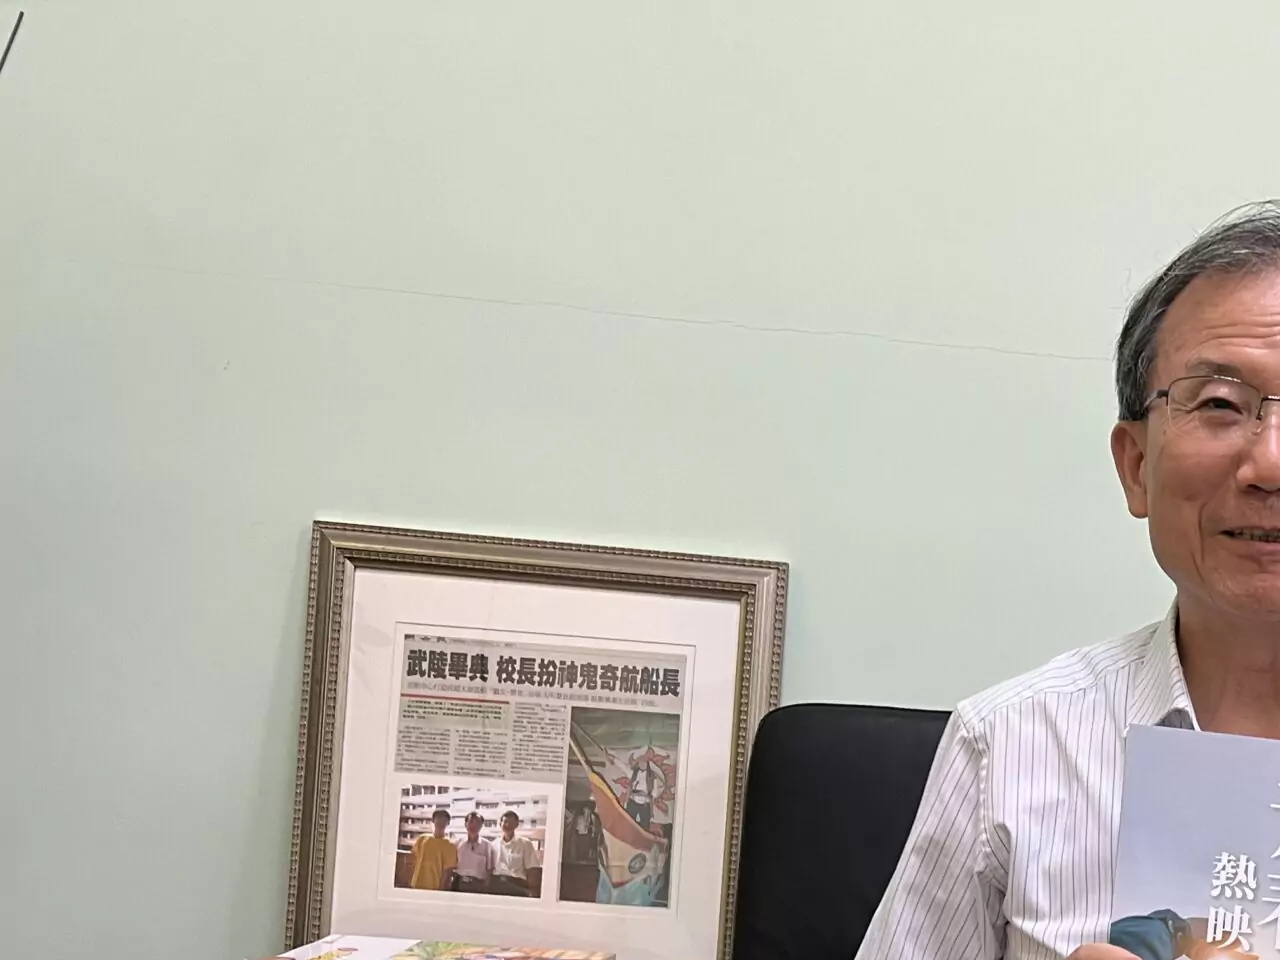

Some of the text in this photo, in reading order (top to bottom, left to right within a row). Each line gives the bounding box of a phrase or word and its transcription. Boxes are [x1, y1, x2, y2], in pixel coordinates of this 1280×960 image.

[407, 649, 489, 683] 武陵畢典
[496, 655, 680, 697] 校長扮神鬼奇航船長
